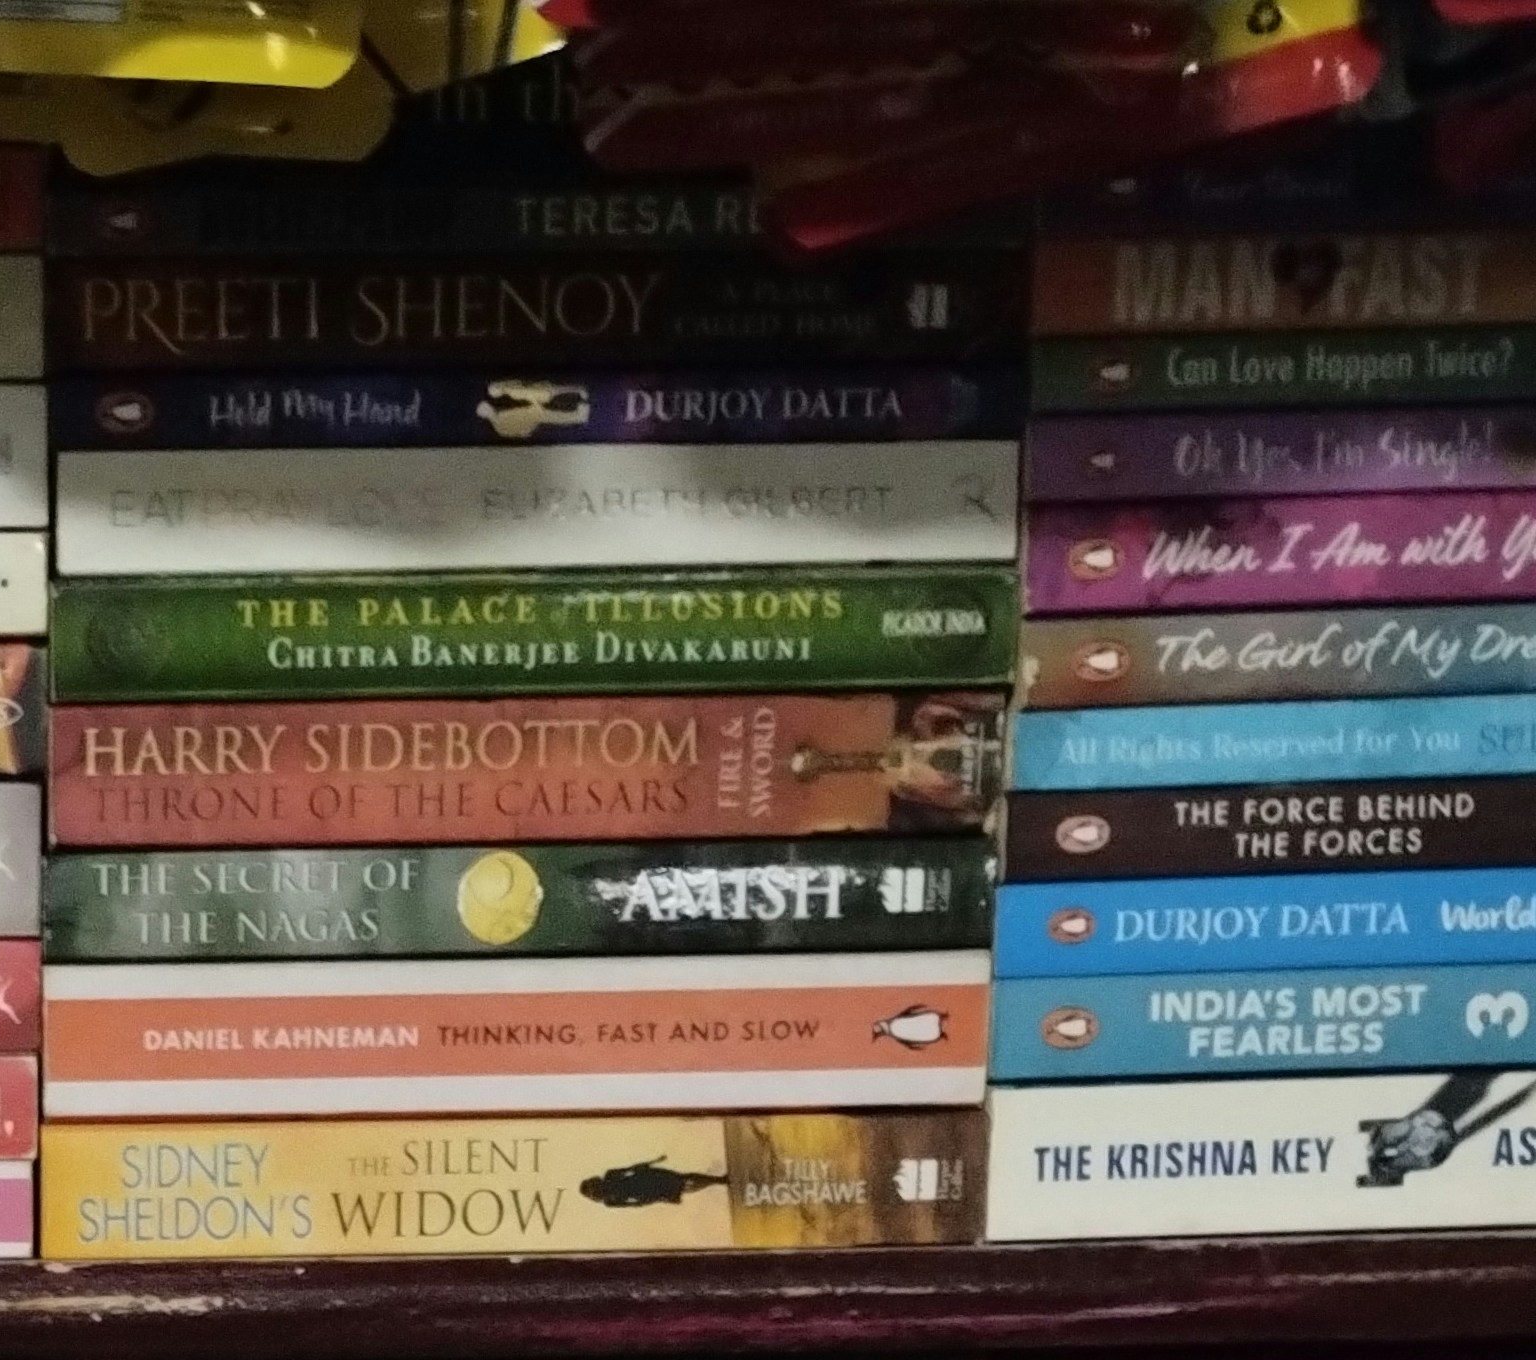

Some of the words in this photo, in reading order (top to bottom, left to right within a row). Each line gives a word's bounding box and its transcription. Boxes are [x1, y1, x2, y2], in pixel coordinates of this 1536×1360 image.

[1175, 801, 1230, 828] THE
[1244, 799, 1344, 823] FORCE
[1358, 793, 1475, 822] BEHIND
[1236, 833, 1289, 858] THE
[1304, 828, 1424, 855] FORCES
[1114, 906, 1268, 947] DURJOY
[1280, 901, 1410, 938] DATTA
[1149, 988, 1296, 1022] INDIA'S
[1312, 983, 1427, 1017] MOST
[144, 1029, 244, 1052] DANIEL
[252, 1026, 419, 1051] KAHNEMAN
[598, 1020, 657, 1045] FAST
[671, 1020, 729, 1043] AND
[741, 1017, 819, 1041] SLOW
[1189, 1023, 1384, 1058] FEARLESS
[403, 1138, 547, 1177] SILENT
[1035, 1147, 1092, 1182] THE
[1107, 1140, 1258, 1180] KRISHNA
[1272, 1137, 1334, 1174] KEY
[333, 1189, 565, 1239] WIDOW
